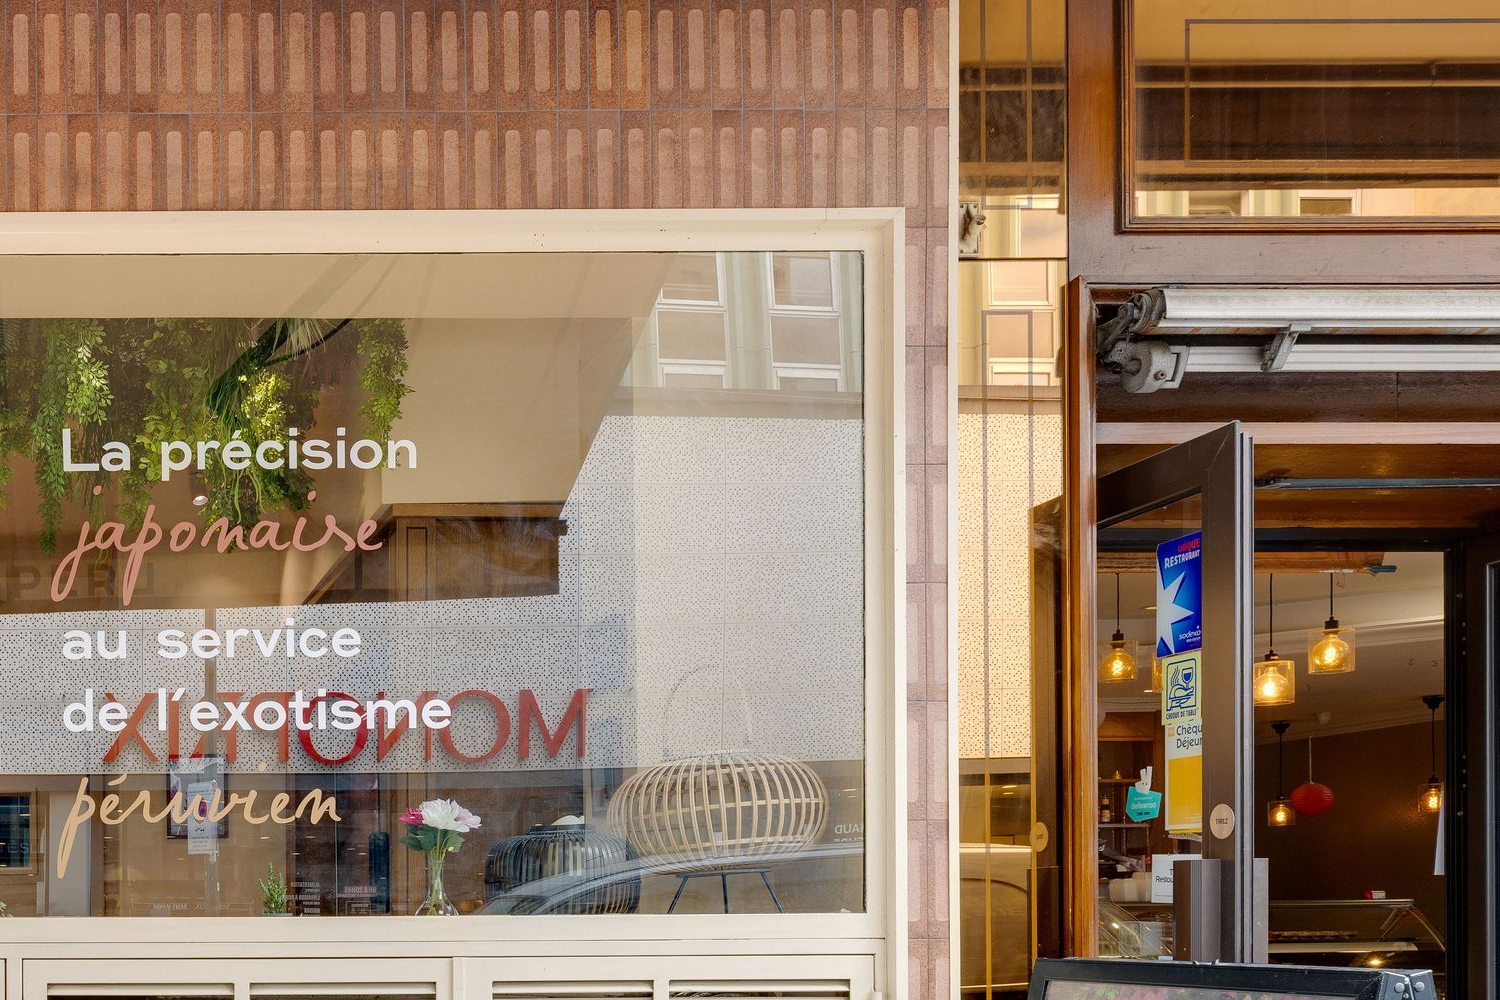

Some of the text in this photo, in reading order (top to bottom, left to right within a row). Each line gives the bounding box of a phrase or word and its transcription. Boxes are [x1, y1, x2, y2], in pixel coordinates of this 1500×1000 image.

[62, 427, 417, 482] La précision
[50, 485, 384, 607] japonaise
[1164, 549, 1201, 570] RESTAURANT
[62, 617, 362, 660] au service
[63, 688, 128, 732] de
[56, 761, 342, 880] péruvien
